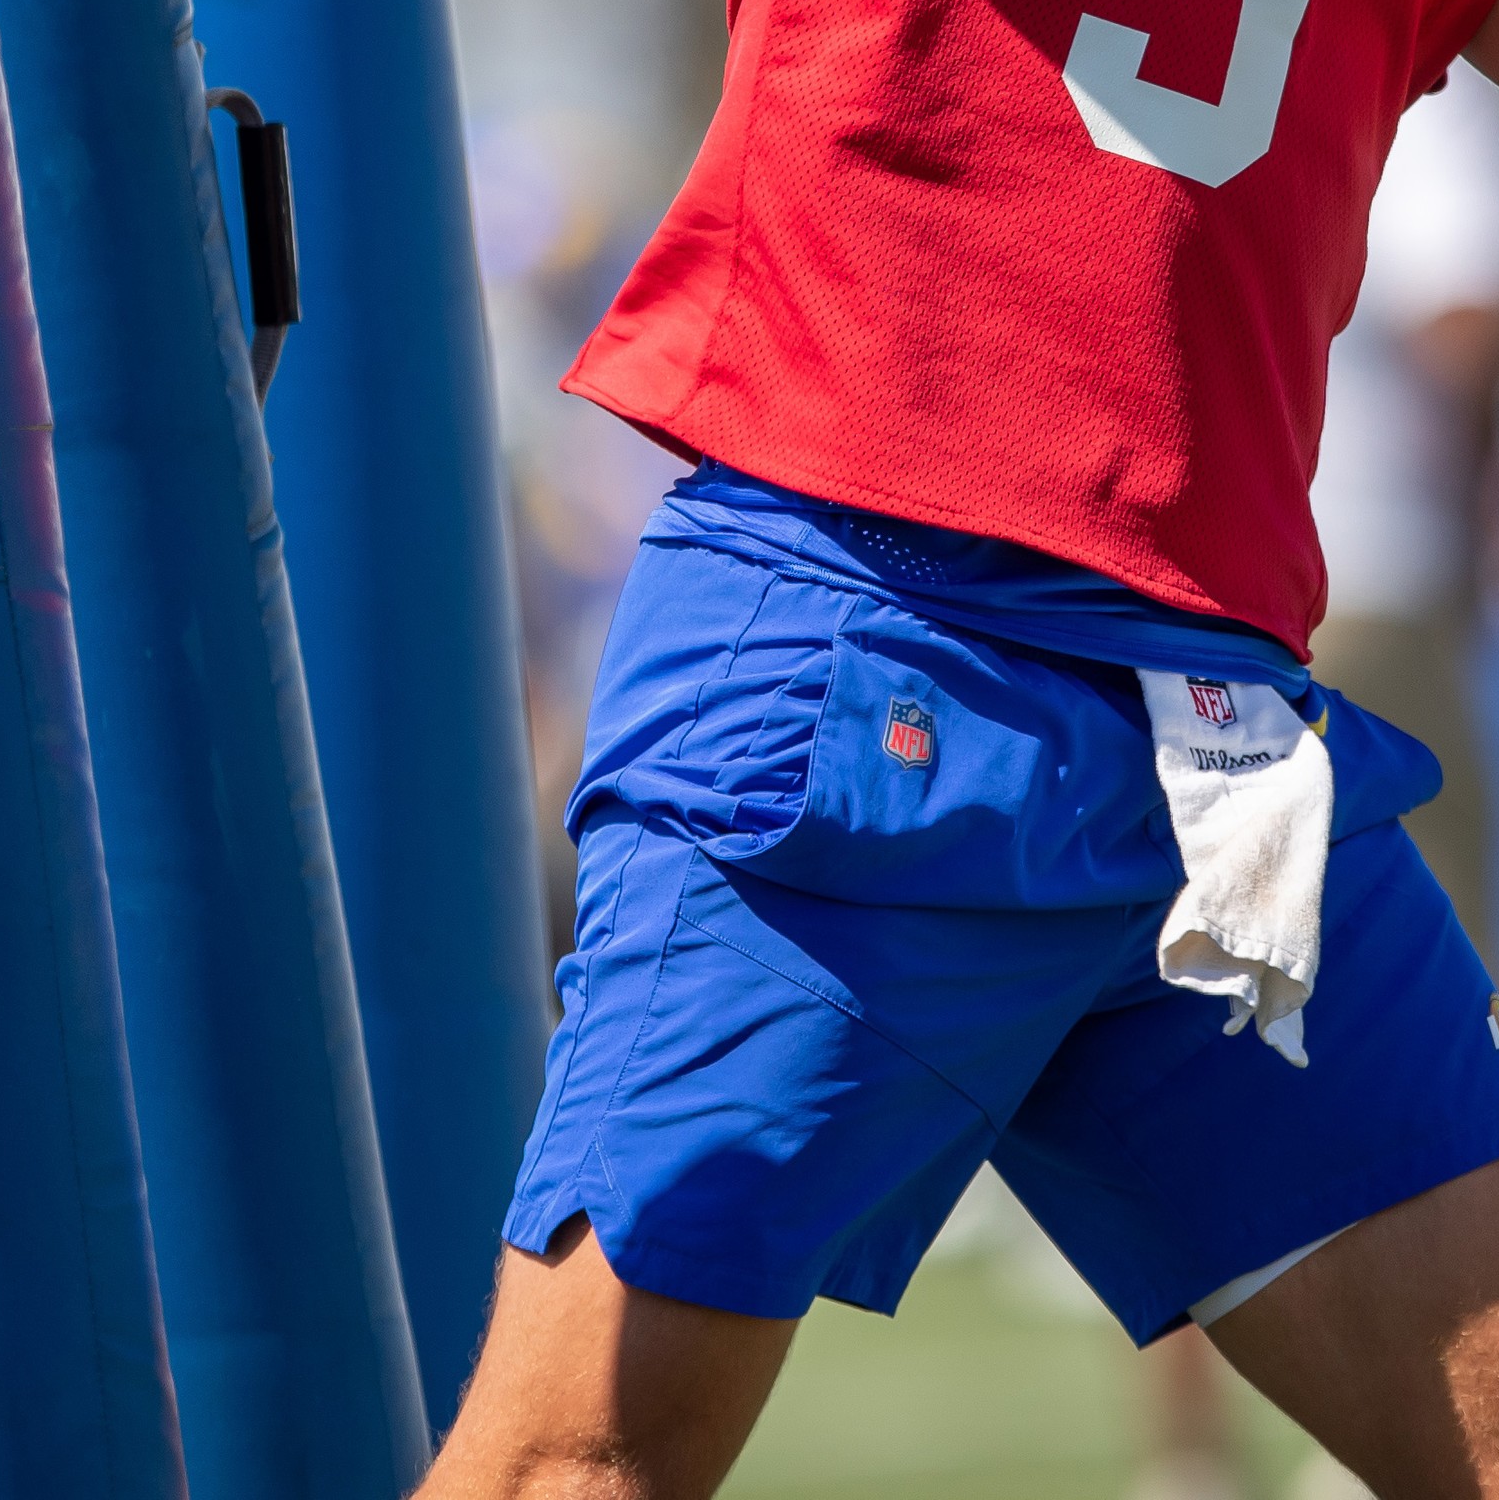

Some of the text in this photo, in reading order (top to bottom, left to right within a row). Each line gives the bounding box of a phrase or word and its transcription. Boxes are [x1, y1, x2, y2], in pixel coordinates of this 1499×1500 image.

[1188, 686, 1231, 724] NFL
[890, 723, 928, 759] NFL
[1190, 746, 1271, 771] Wilson
